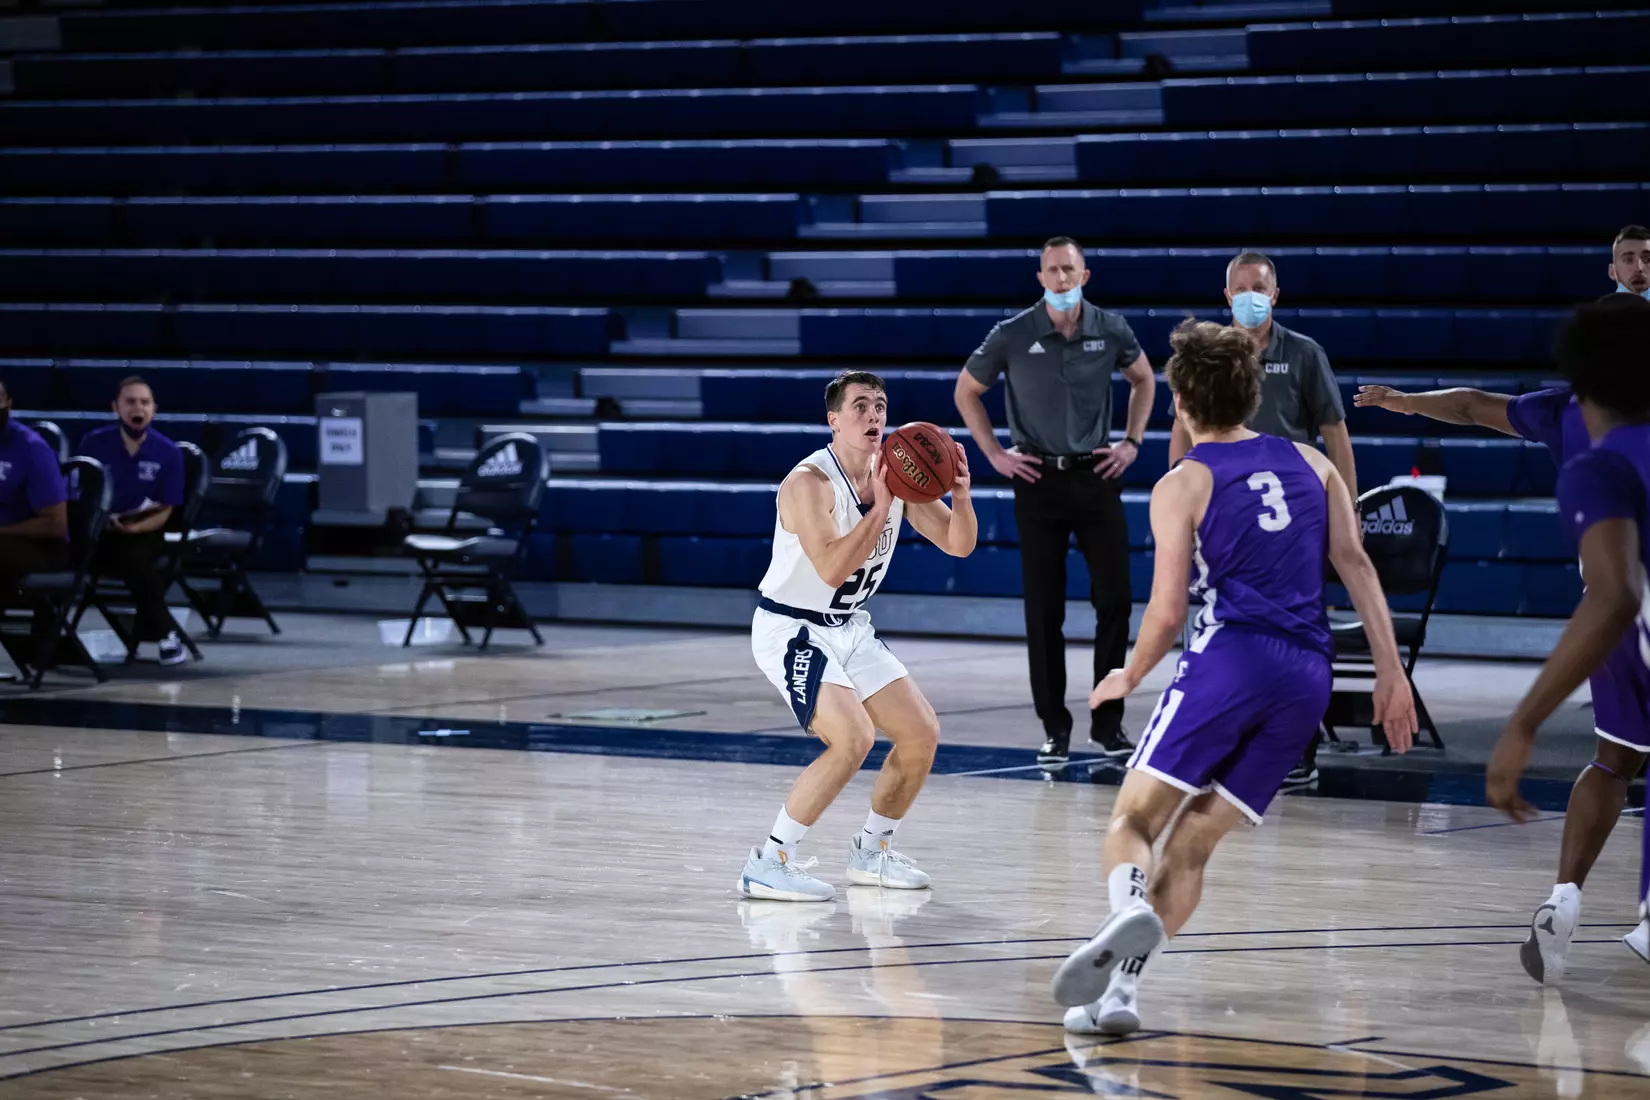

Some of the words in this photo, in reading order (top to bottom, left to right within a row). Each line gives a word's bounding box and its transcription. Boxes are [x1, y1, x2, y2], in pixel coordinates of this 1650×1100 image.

[1083, 340, 1105, 352] CBU
[1265, 362, 1289, 374] CBU
[892, 442, 931, 489] Wilson
[913, 432, 942, 465] NCAA
[1246, 470, 1292, 532] 3
[829, 561, 884, 611] 25
[791, 649, 813, 704] LANCERS
